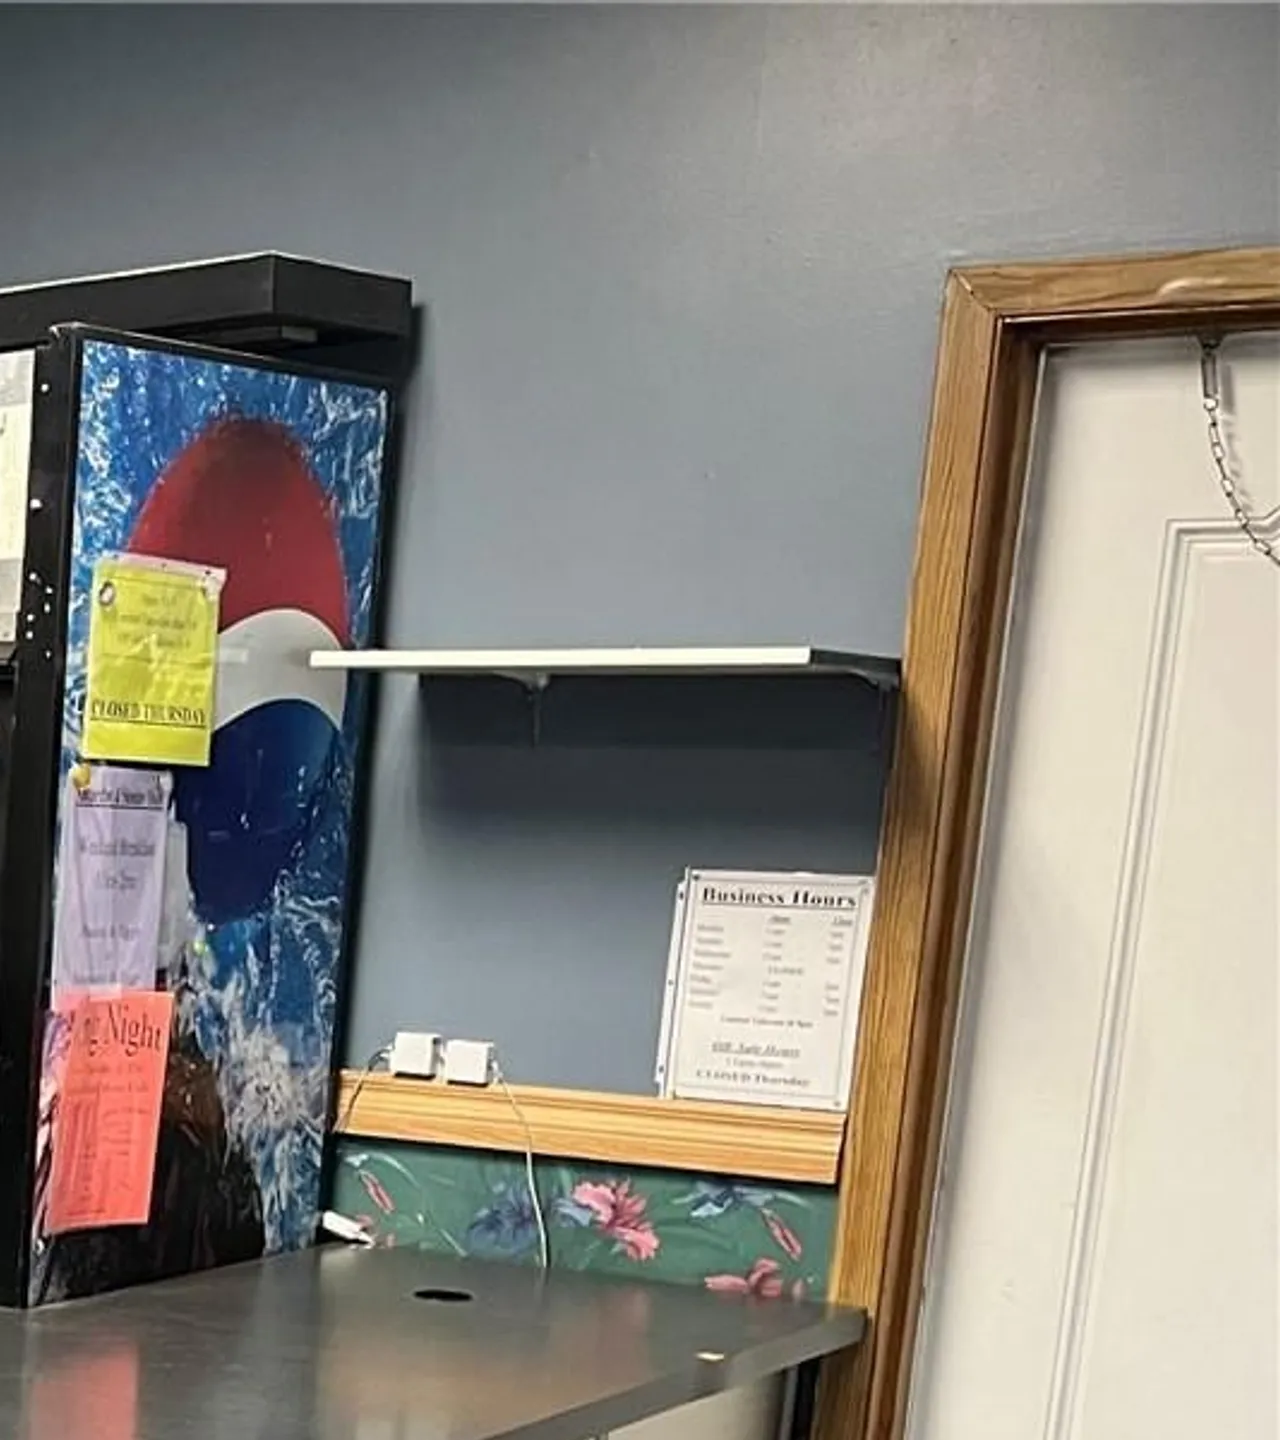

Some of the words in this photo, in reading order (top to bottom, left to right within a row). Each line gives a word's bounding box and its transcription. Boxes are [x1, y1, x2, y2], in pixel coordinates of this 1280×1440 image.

[704, 887, 784, 904] Business
[793, 891, 856, 908] Hours
[107, 1002, 161, 1057] Night
